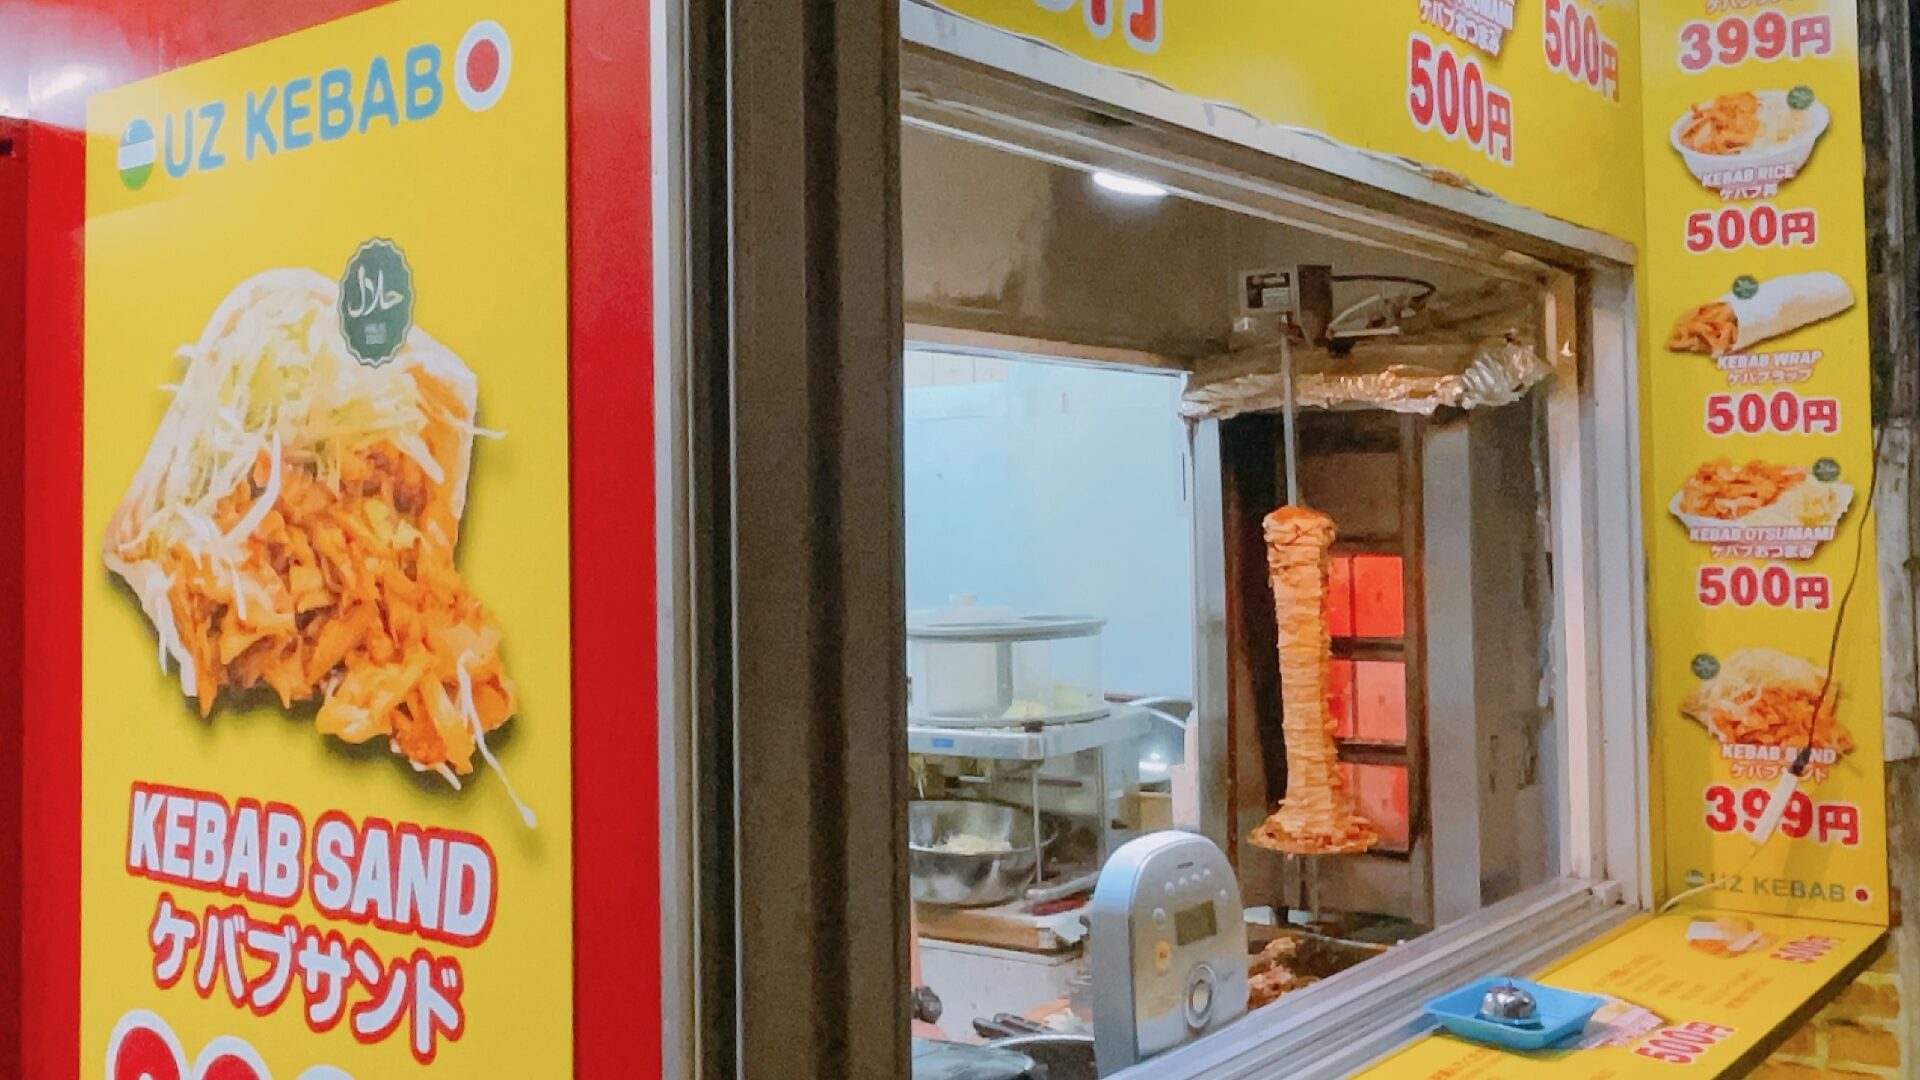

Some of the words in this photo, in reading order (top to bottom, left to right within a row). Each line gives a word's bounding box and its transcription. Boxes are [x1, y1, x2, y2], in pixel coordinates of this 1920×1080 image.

[1544, 0, 1620, 104] 500円
[1680, 11, 1833, 71] 399円
[163, 101, 226, 179] UZ
[244, 43, 444, 161] KEBAB
[1408, 36, 1514, 164] 500円
[1686, 205, 1817, 252] 500円
[1706, 391, 1838, 435] 500円
[1698, 565, 1830, 610] 500円
[1784, 745, 1837, 765] SND
[128, 786, 304, 903] KEBAB
[310, 815, 495, 943] SAND
[1752, 875, 1847, 903] KEBAB
[151, 896, 462, 1059] ケバブサンド
[1632, 1019, 1738, 1065] 500円
